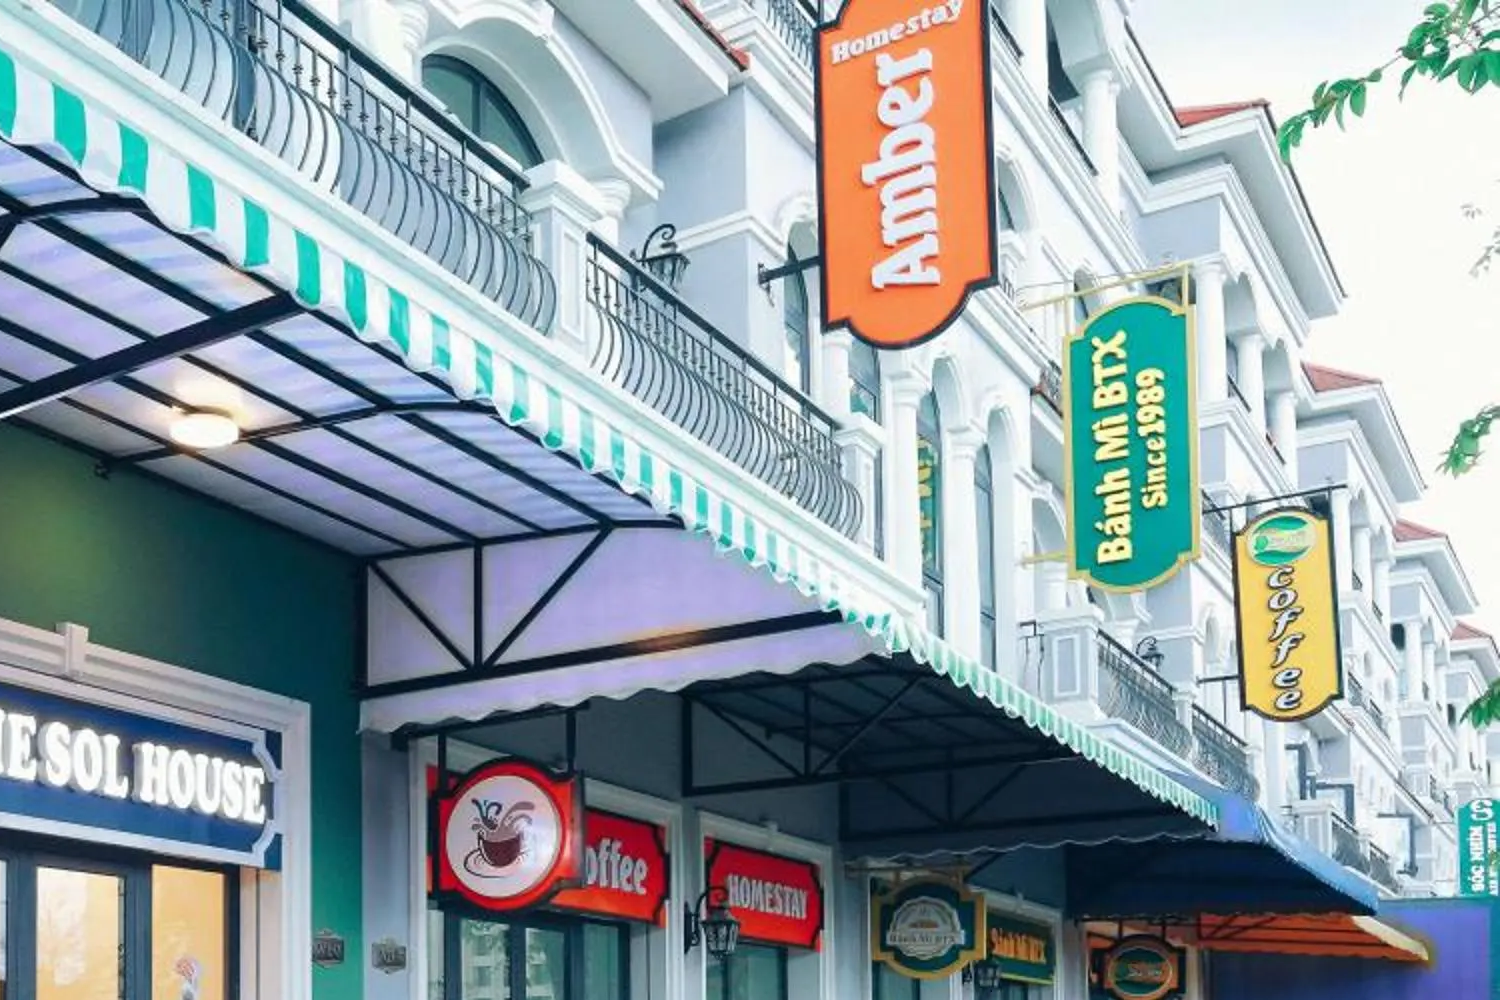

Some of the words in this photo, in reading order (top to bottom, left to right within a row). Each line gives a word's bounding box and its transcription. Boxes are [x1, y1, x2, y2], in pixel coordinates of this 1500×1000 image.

[831, 0, 963, 64] Homestay
[861, 48, 941, 289] Amber
[1092, 330, 1129, 409] BTX
[1095, 467, 1134, 564] Bánh
[1267, 565, 1305, 710] coffee
[37, 721, 130, 799] SOL
[132, 741, 267, 825] HOUSE
[585, 837, 648, 896] offee
[728, 873, 810, 920] HOMESTAY
